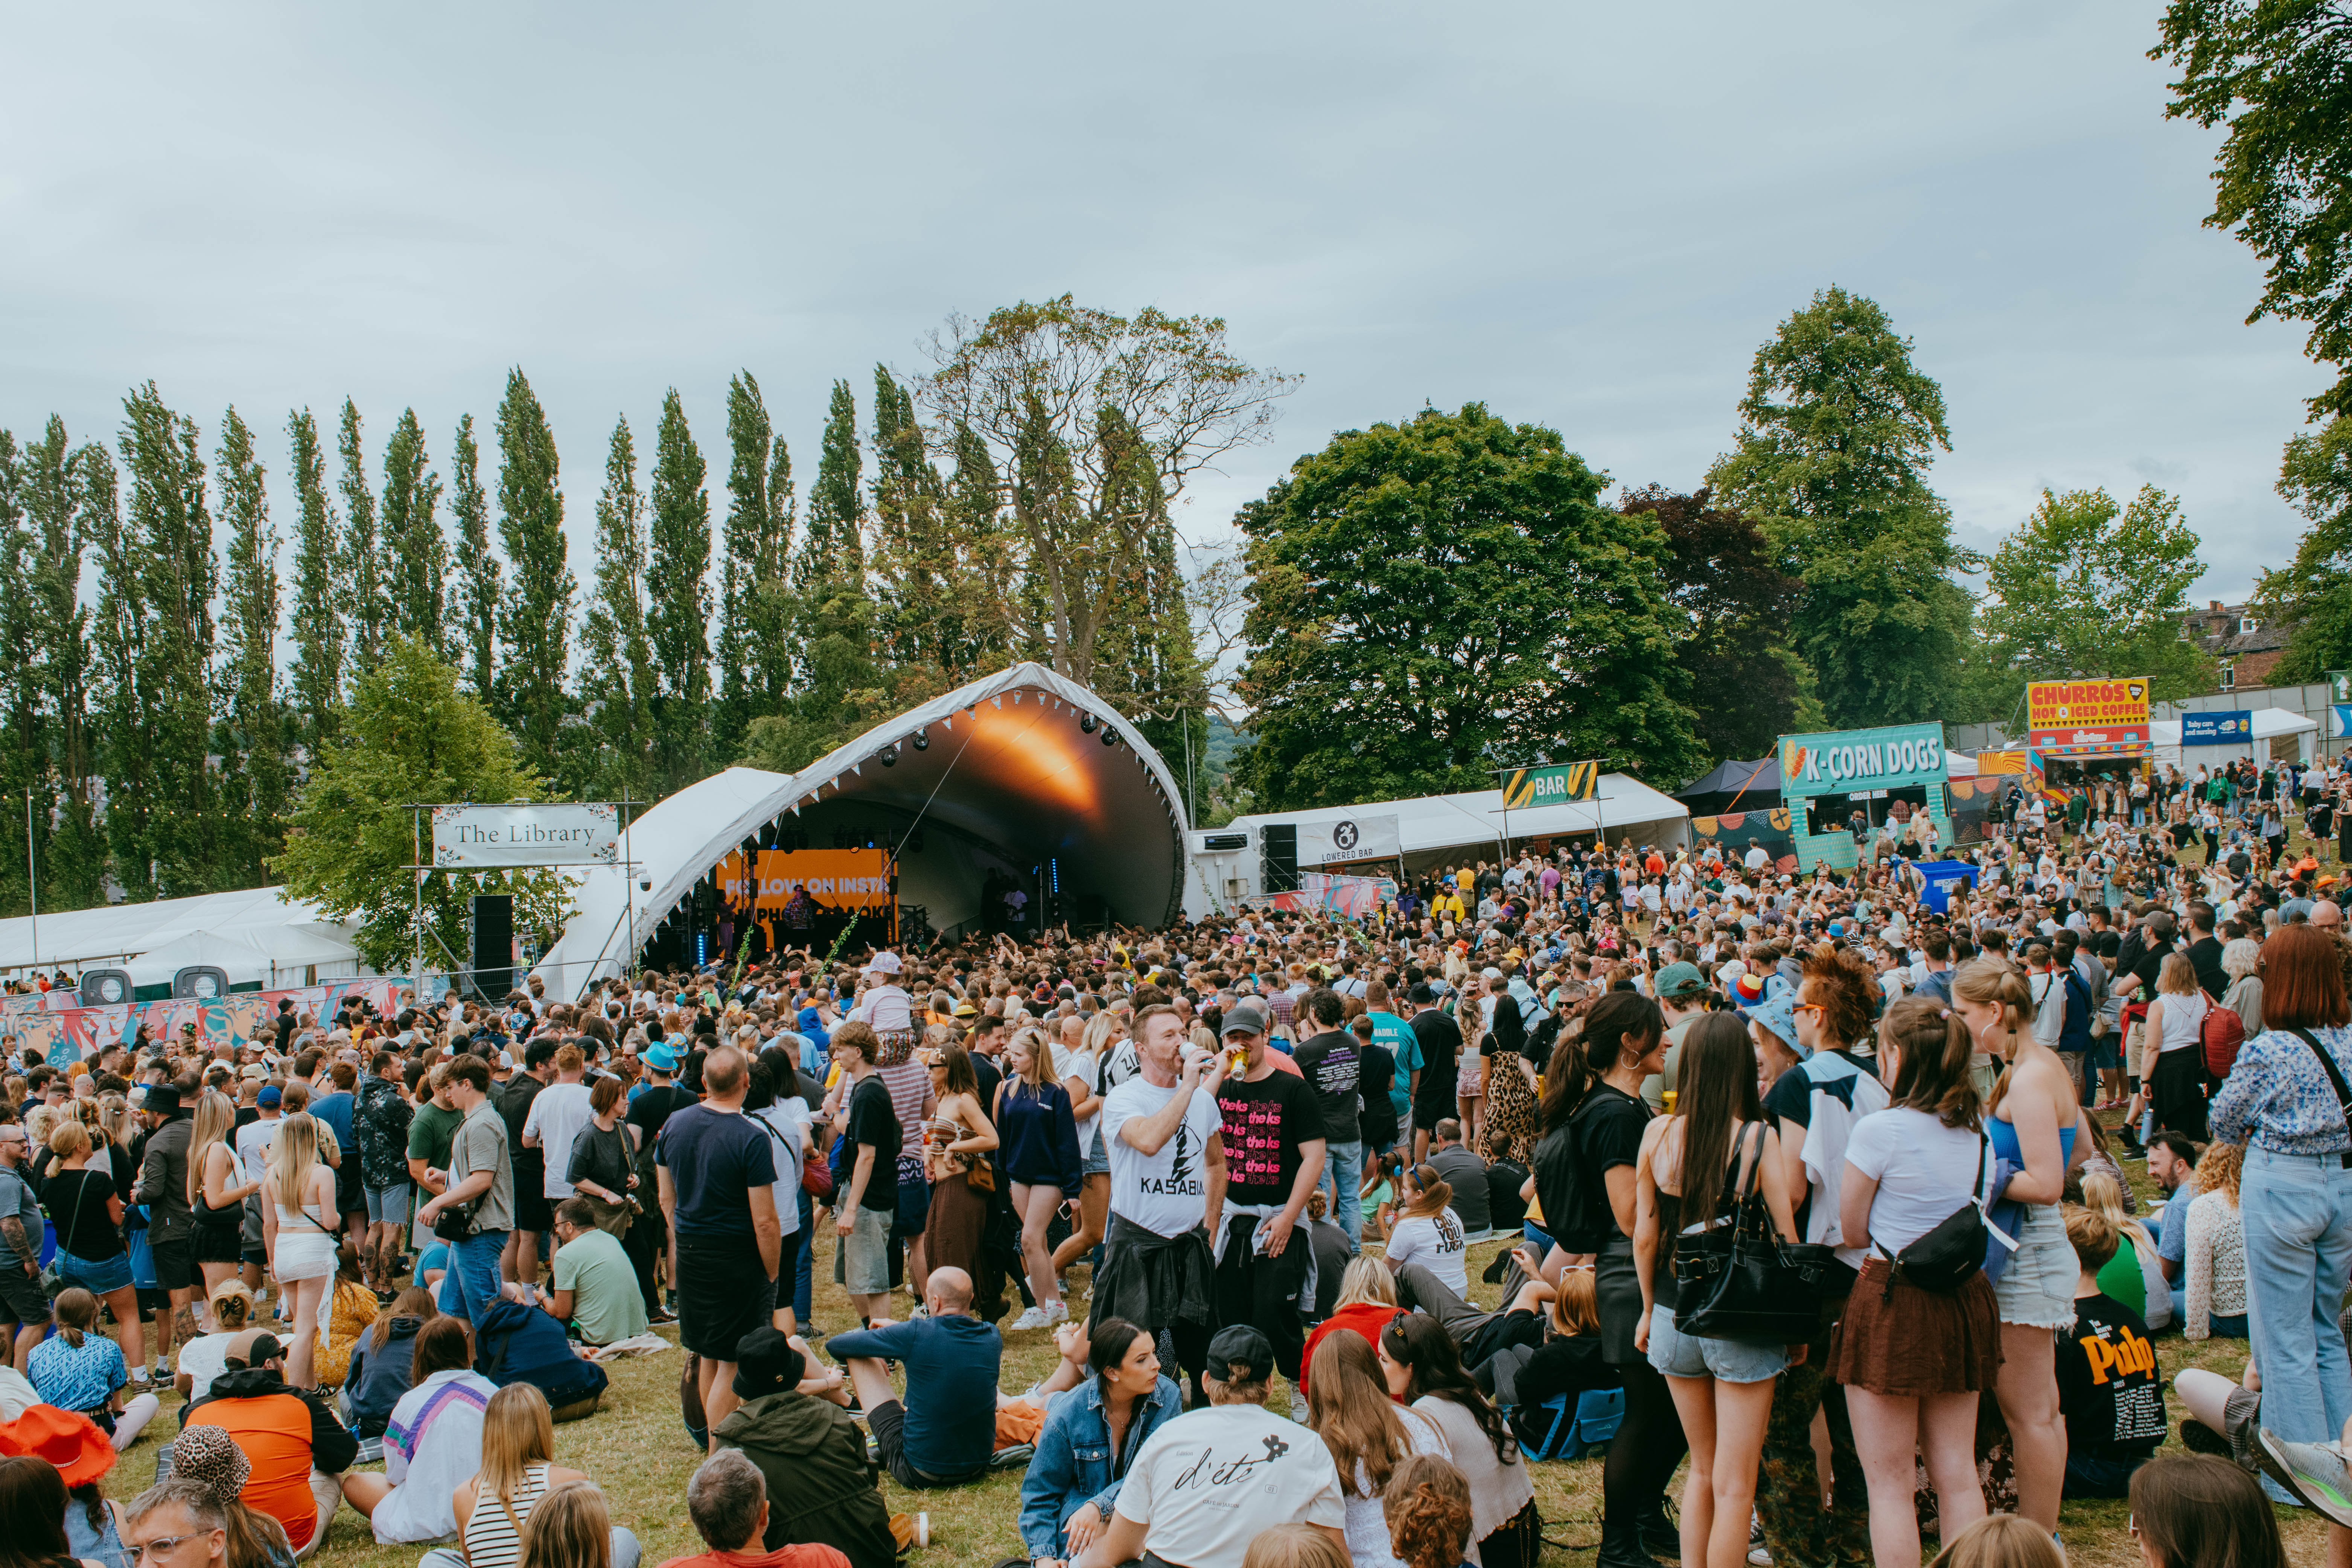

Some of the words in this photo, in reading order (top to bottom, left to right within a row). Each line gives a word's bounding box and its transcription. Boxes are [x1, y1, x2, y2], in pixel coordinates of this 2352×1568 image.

[2032, 684, 2125, 705] CHURROS
[2032, 708, 2056, 719] HOT
[2071, 705, 2098, 717] ICED
[2102, 703, 2145, 716] COFFEE
[2196, 728, 2217, 736] nursing
[1807, 744, 1885, 783] K-CORN
[1887, 737, 1941, 775] DOGS
[1535, 775, 1566, 796] BAR
[1848, 792, 1871, 801] ORDER
[1872, 789, 1888, 799] HERE
[455, 824, 499, 843] The
[509, 823, 596, 846] Library
[1322, 851, 1355, 862] LOWERED
[1359, 848, 1373, 857] BAR
[726, 878, 804, 895] FOLOW
[807, 877, 835, 894] ON
[1219, 1098, 1236, 1111] the
[1236, 1099, 1248, 1112] ks
[1249, 1100, 1268, 1111] the
[1267, 1100, 1282, 1112] ks
[1248, 1111, 1266, 1124] the
[1266, 1111, 1281, 1125] ks
[1233, 1123, 1246, 1136] ks
[1247, 1124, 1266, 1136] the
[1267, 1123, 1280, 1136] ks
[1246, 1136, 1266, 1148] the
[1266, 1136, 1280, 1149] ks
[1246, 1148, 1266, 1160] the
[1267, 1148, 1280, 1161] ks
[1245, 1160, 1266, 1172] the
[1267, 1160, 1280, 1173] ks
[1232, 1169, 1245, 1183] ks
[1246, 1172, 1265, 1184] the
[1266, 1172, 1280, 1184] ks
[1437, 1224, 1460, 1243] YOU
[2088, 1319, 2101, 1328] You
[2095, 1324, 2113, 1335] deserve
[2097, 1332, 2111, 1340] more
[2079, 1325, 2155, 1385] Pulp
[2113, 1379, 2125, 1389] 2025
